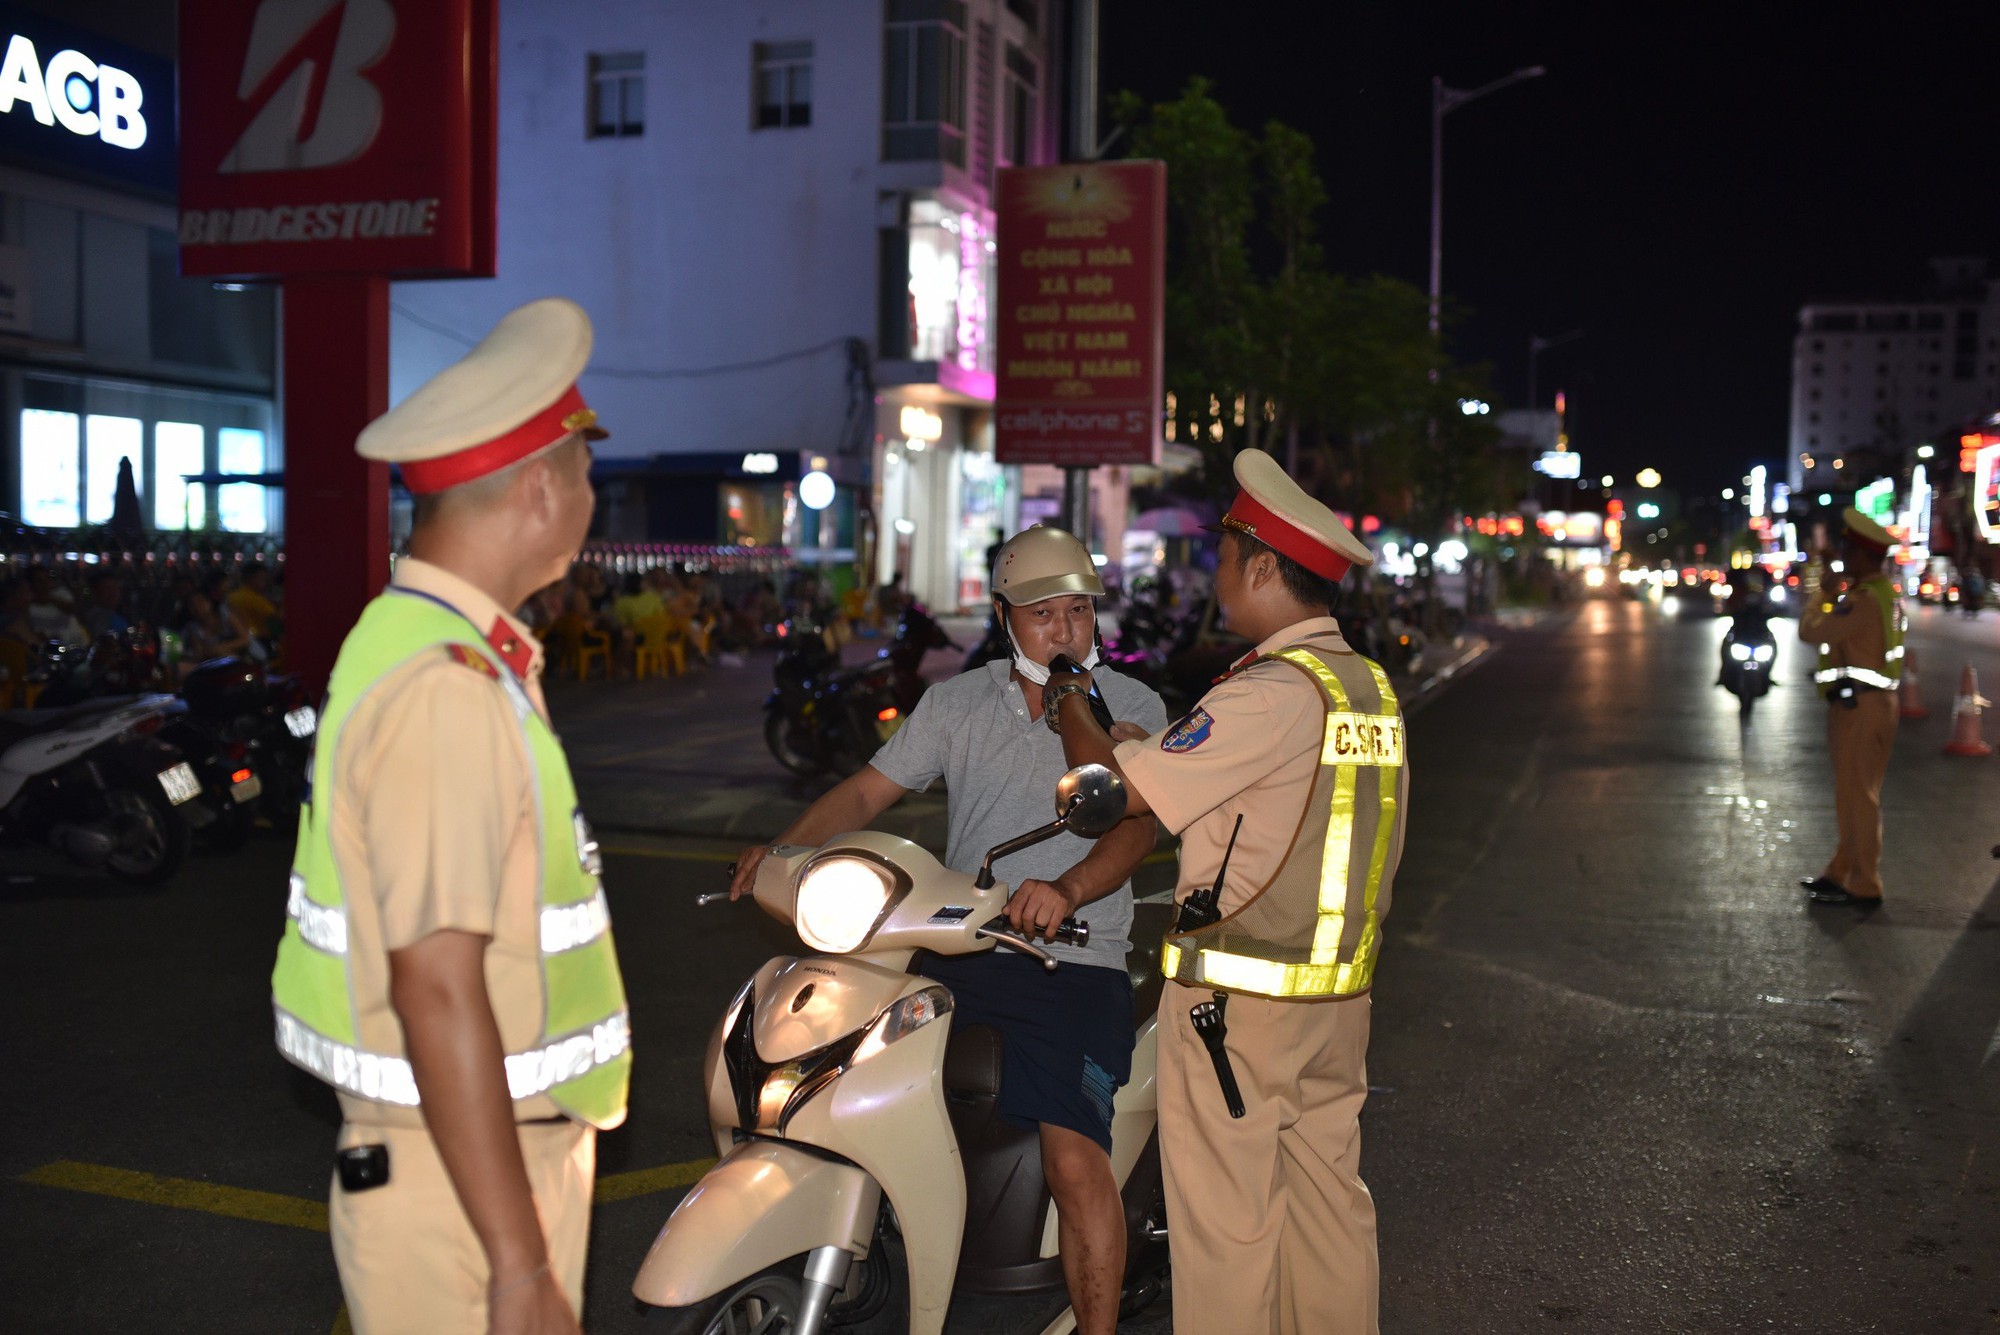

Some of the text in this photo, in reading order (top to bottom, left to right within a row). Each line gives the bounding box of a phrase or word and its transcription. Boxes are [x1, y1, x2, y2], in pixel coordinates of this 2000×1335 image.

[0, 34, 147, 150] ACB
[179, 198, 438, 246] BRIDGESTONE
[1075, 331, 1128, 349] NAM
[803, 966, 837, 977] HONDA
